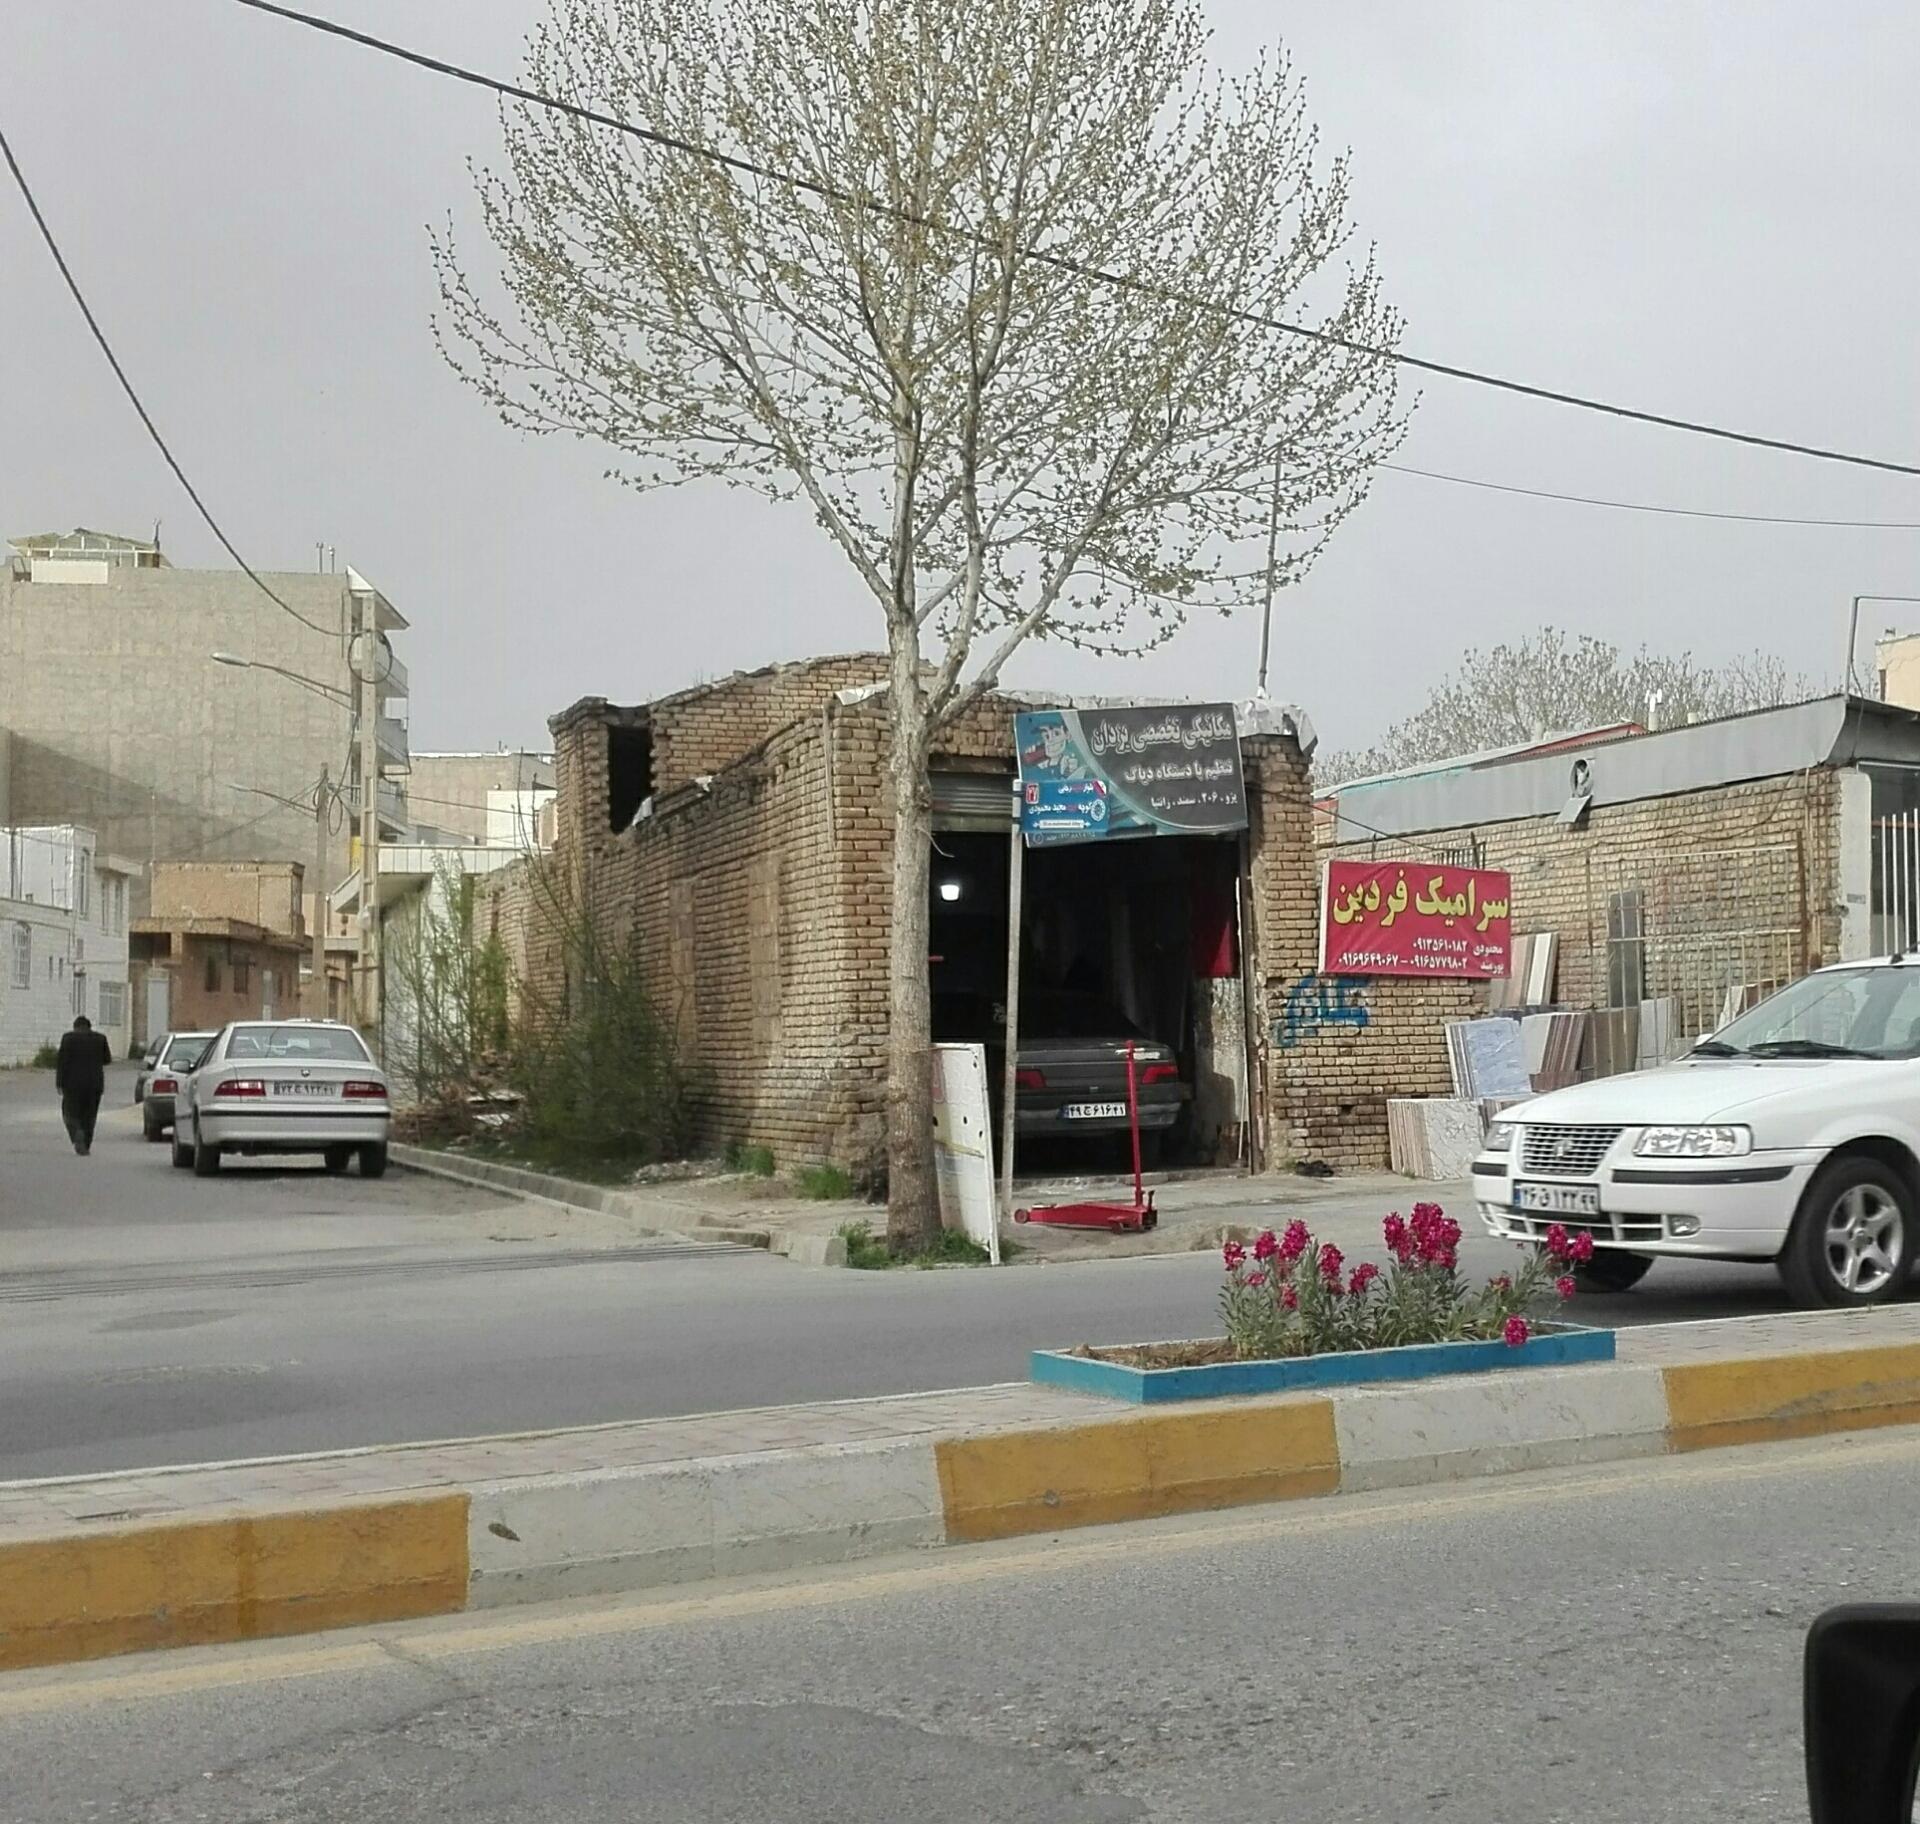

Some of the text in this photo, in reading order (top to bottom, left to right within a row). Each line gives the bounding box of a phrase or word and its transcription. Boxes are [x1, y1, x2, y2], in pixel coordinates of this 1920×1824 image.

[1092, 712, 1233, 755] مکانیکی تخصصی یزدان
[1157, 762, 1192, 780] دستگاه
[1195, 760, 1203, 781] با
[1205, 759, 1233, 780] تنظیم
[1202, 791, 1218, 803] ۲۰۶
[1333, 869, 1509, 931] سرامیک فردین
